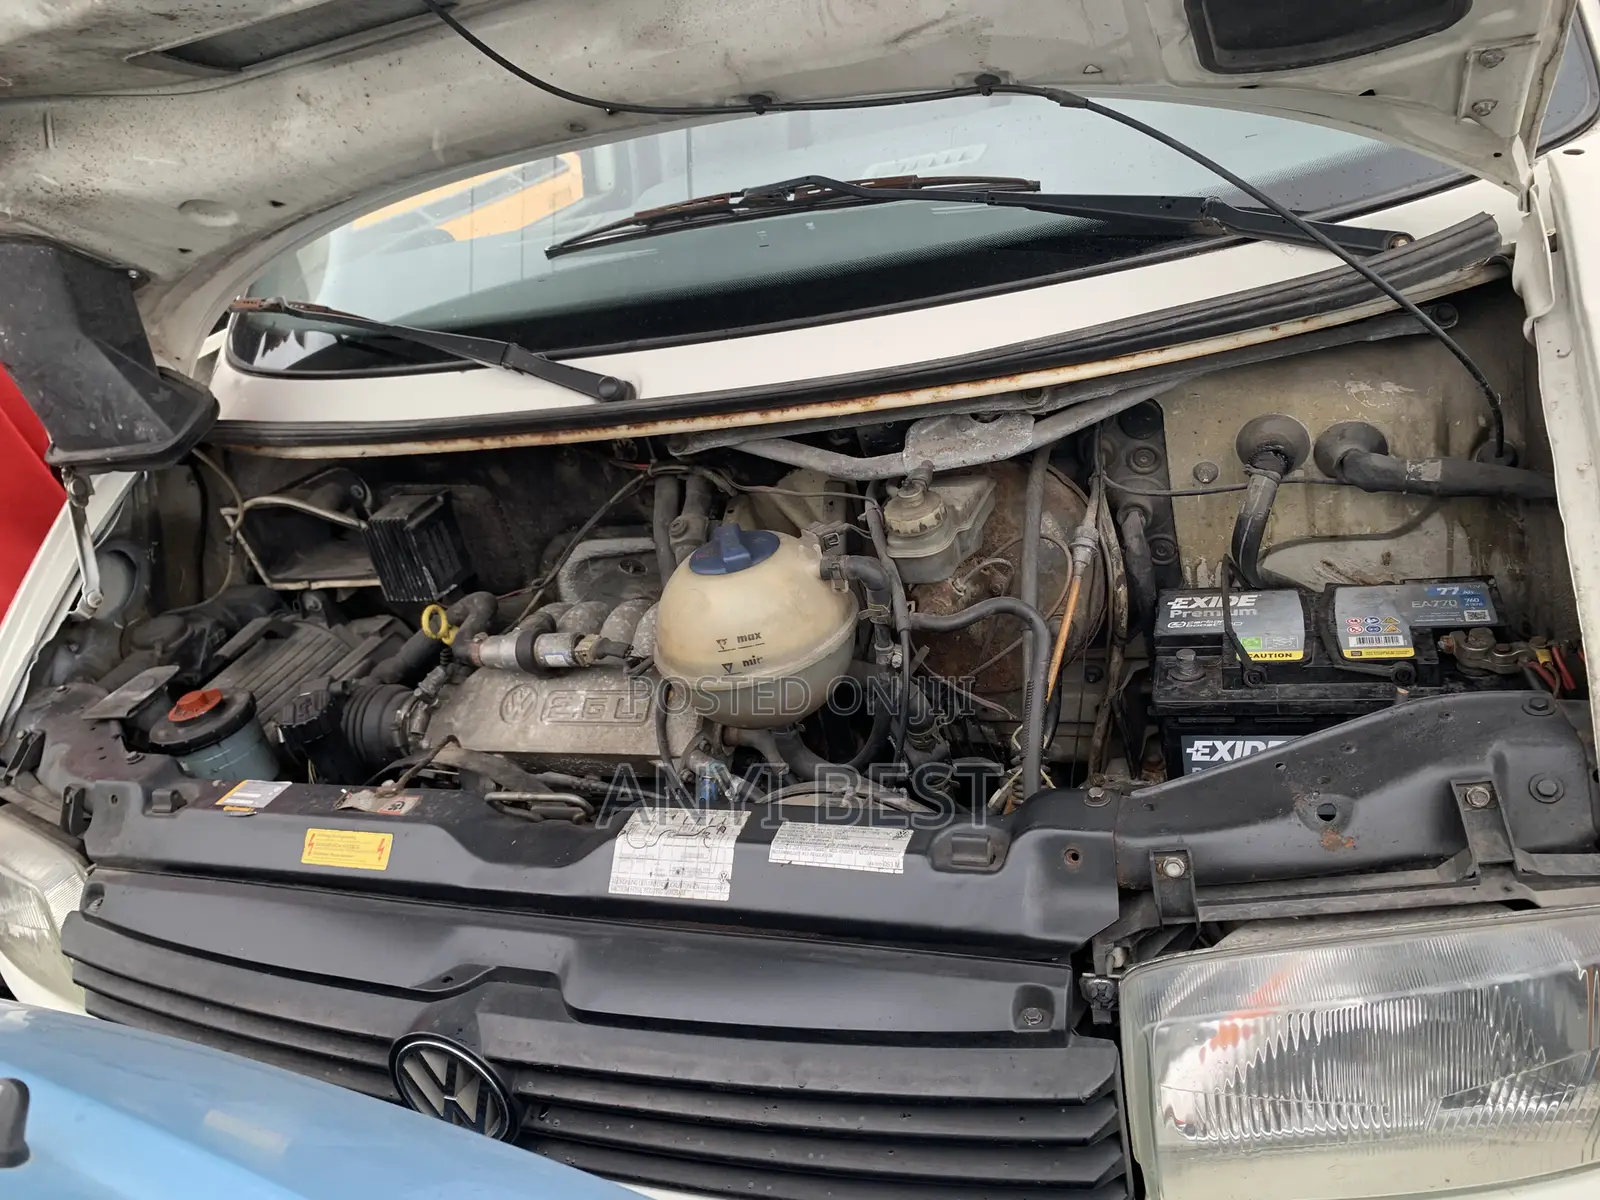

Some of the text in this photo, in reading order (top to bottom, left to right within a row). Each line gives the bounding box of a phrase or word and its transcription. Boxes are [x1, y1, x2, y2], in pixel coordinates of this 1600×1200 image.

[1437, 587, 1459, 596] 77
[1166, 594, 1259, 610] EXIDE
[1412, 599, 1458, 608] EA770
[737, 632, 762, 644] max
